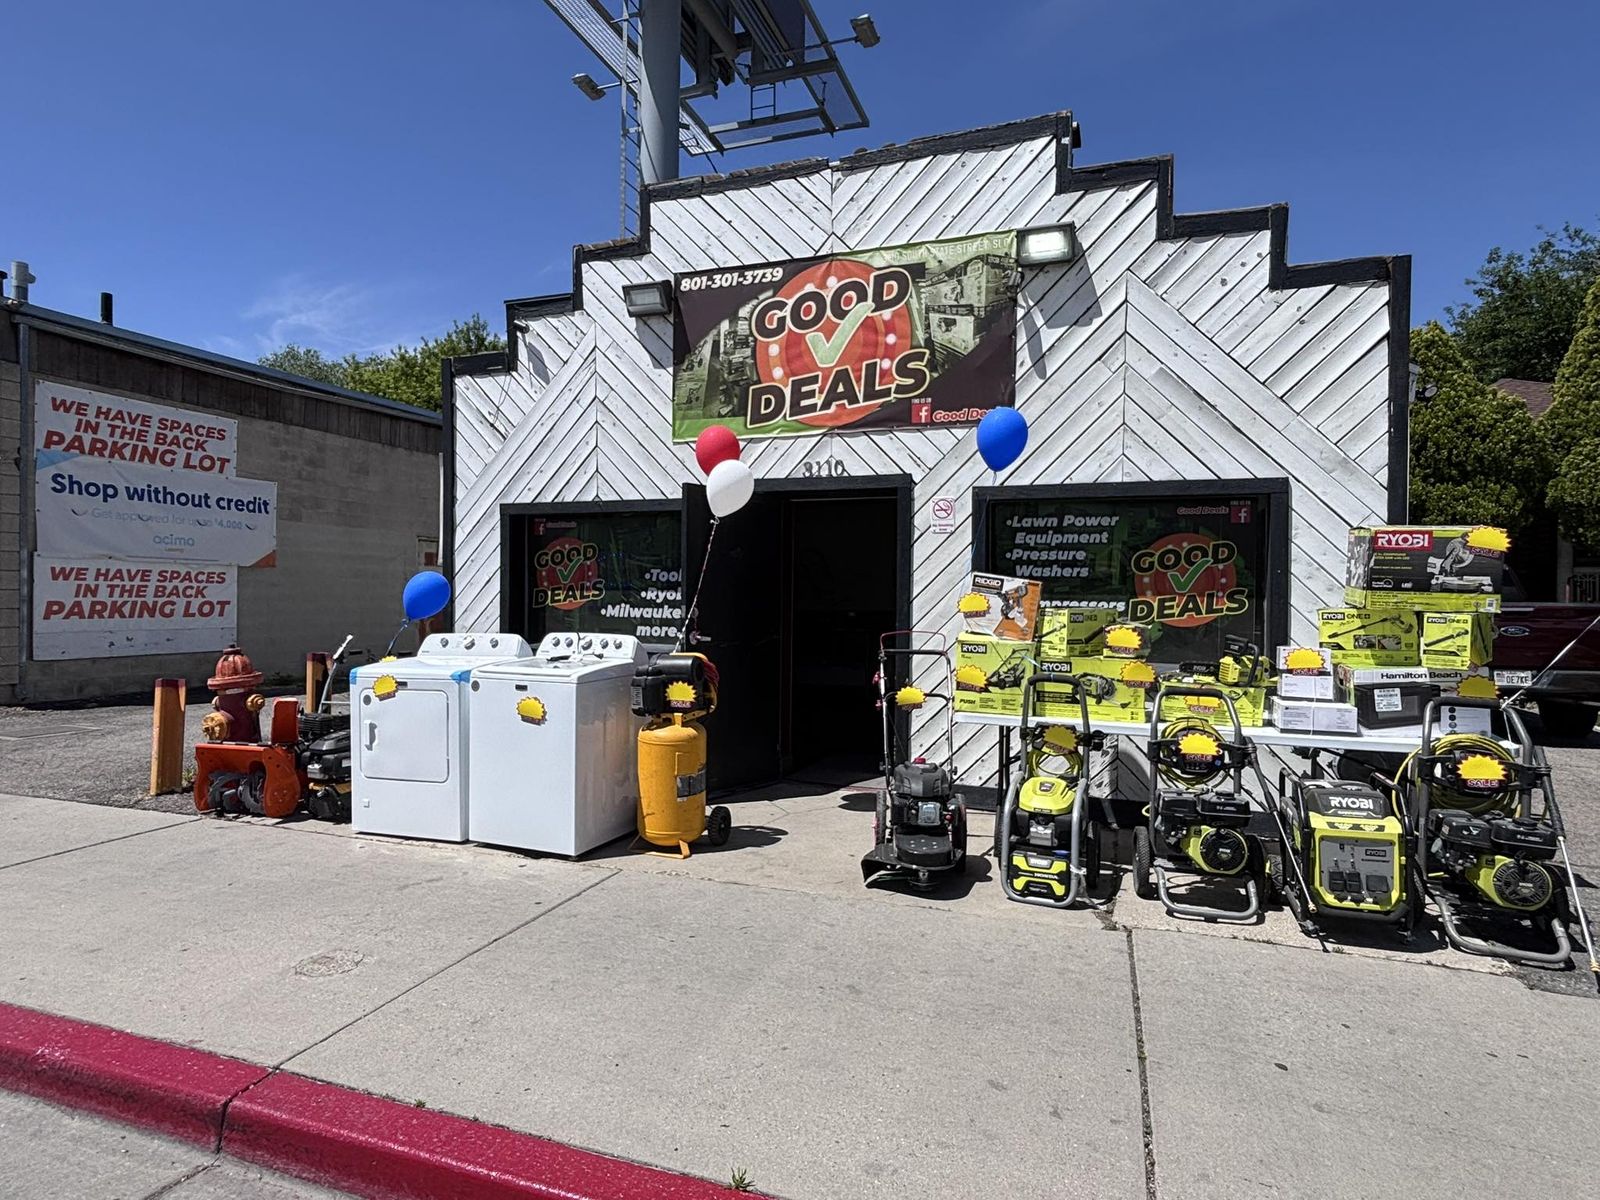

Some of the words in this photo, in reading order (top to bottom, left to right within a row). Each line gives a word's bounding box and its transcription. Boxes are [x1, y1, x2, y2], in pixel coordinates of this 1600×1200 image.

[680, 267, 783, 292] 801-301-3739
[751, 267, 911, 341] GOOD
[746, 350, 929, 429] DEALS
[50, 397, 89, 416] WE
[94, 405, 152, 427] HAVE
[157, 417, 226, 441] SPACES
[933, 408, 968, 422] Good
[968, 408, 990, 420] De
[75, 418, 100, 435] IN
[107, 423, 149, 442] THE
[154, 432, 209, 452] BACK
[43, 430, 177, 467] PARKING
[182, 452, 230, 474] LOT
[51, 473, 118, 502] Shop
[125, 483, 211, 509] without
[215, 496, 271, 515] credit
[1011, 515, 1058, 527] Lawn
[1062, 514, 1119, 527] Power
[1014, 531, 1109, 546] Equipment
[1377, 534, 1429, 547] RYOBI
[534, 542, 598, 569] GOOD
[1011, 549, 1087, 561] Pressure
[1131, 540, 1237, 575] GOOD
[50, 566, 88, 581] WE
[94, 568, 152, 583] HAVE
[156, 570, 227, 585] SPACES
[1015, 564, 1089, 578] Washers
[74, 583, 100, 599] IN
[106, 584, 149, 599] THE
[153, 585, 209, 600] BACK
[532, 578, 605, 608] DEALS
[43, 600, 177, 620] PARKING
[182, 600, 231, 618] LOT
[1128, 587, 1249, 623] DEALS
[963, 645, 986, 653] RYOBI
[1042, 662, 1070, 671] RYOBI
[1381, 671, 1428, 680] Hamilton
[1429, 671, 1462, 679] Beach
[1329, 796, 1374, 810] RYOBI
